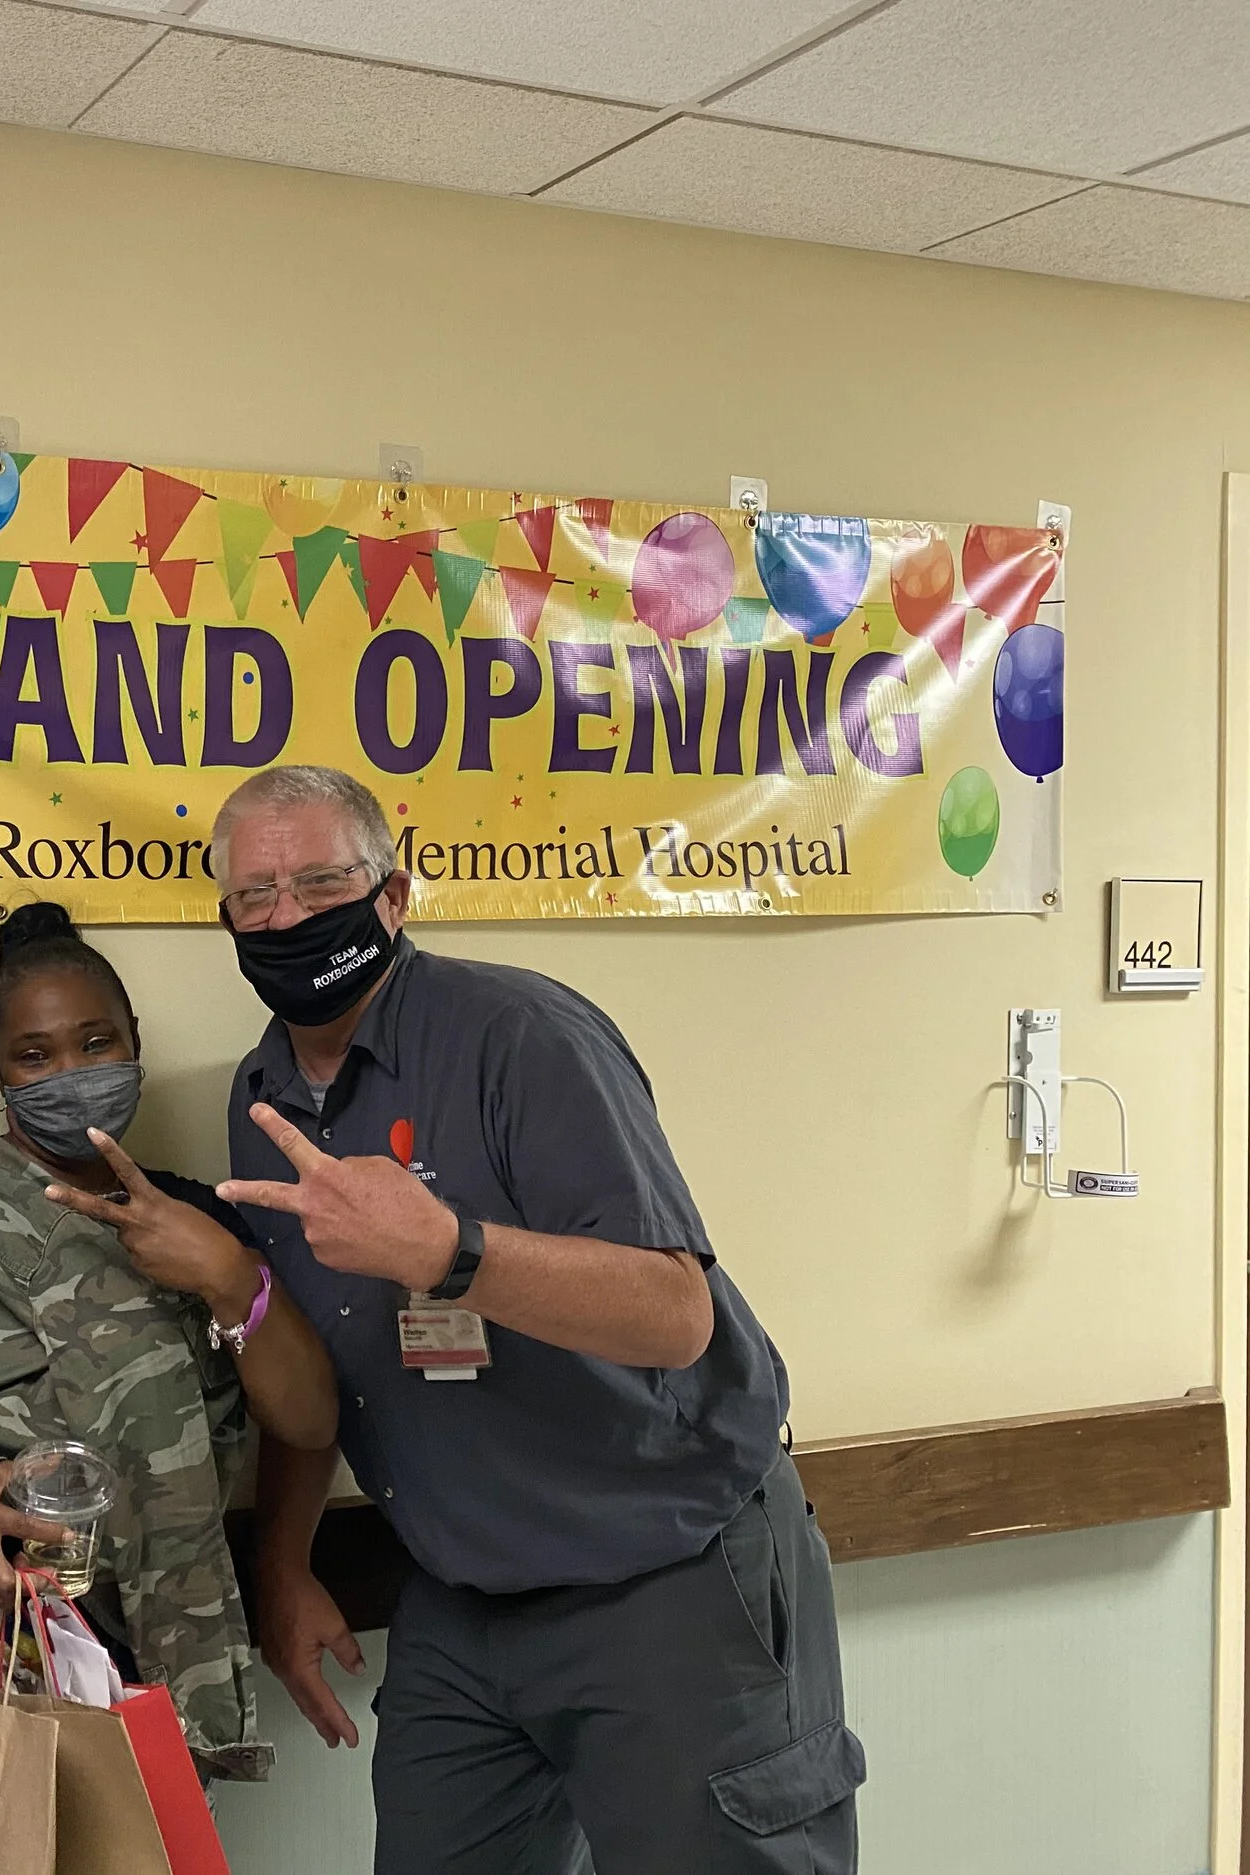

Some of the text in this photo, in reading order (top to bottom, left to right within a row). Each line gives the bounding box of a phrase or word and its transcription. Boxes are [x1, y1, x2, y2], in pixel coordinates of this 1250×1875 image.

[353, 628, 926, 778] OPENING
[639, 823, 852, 891] Hospital
[312, 944, 380, 990] ROXBOROUGH
[329, 945, 359, 966] TEAM
[1123, 940, 1173, 969] 442
